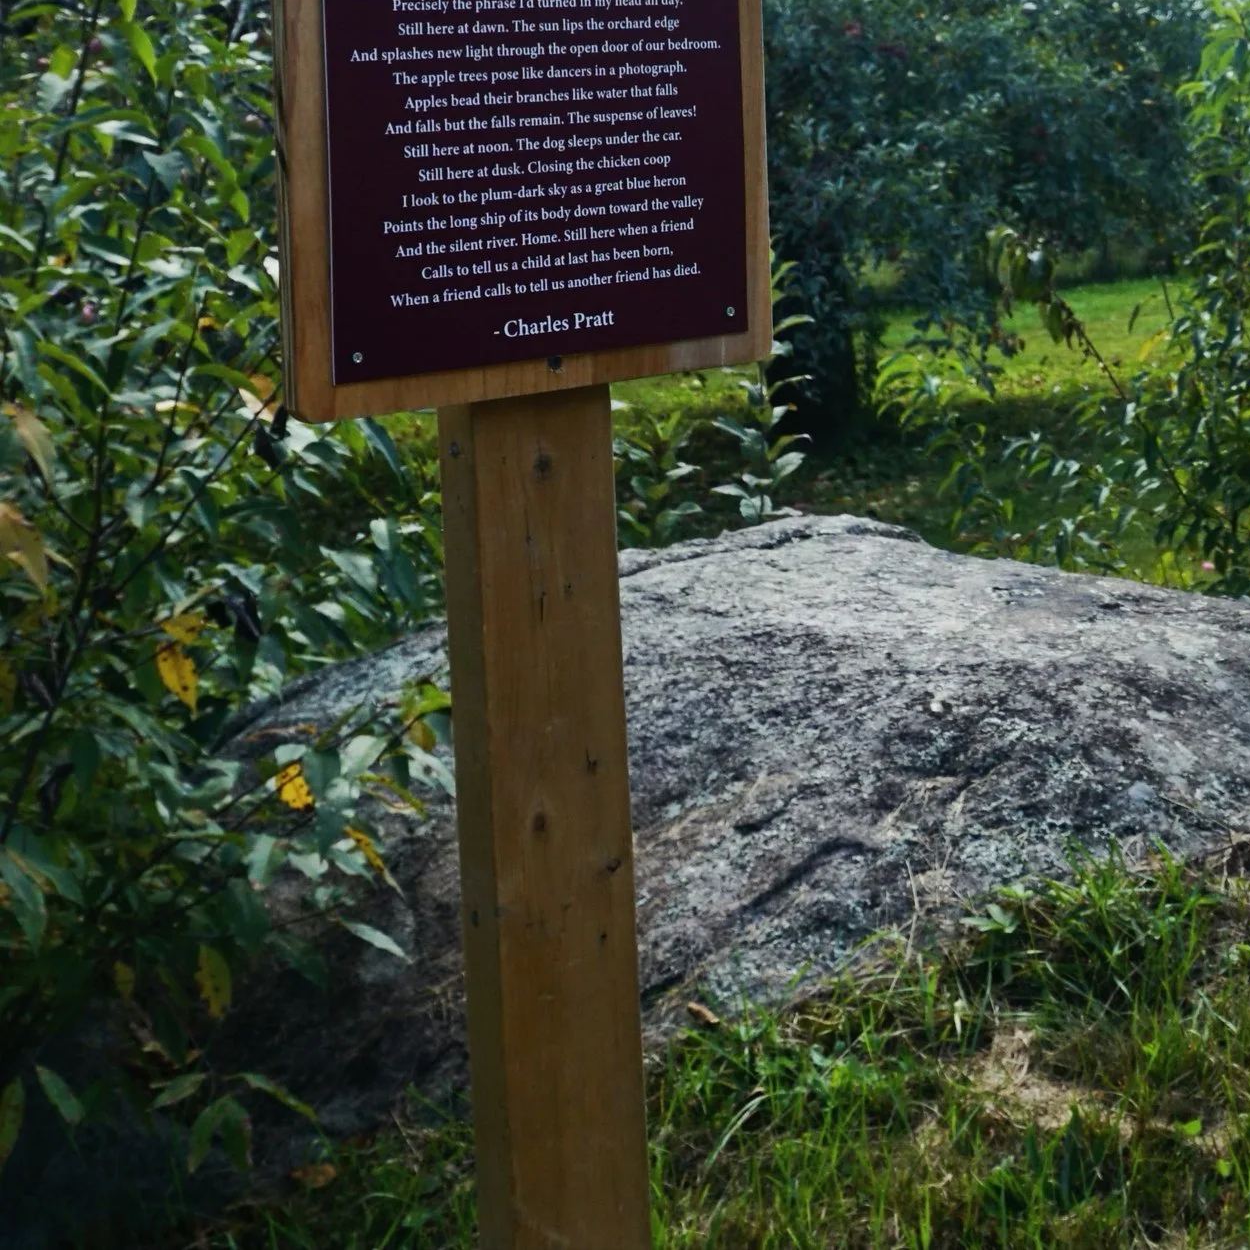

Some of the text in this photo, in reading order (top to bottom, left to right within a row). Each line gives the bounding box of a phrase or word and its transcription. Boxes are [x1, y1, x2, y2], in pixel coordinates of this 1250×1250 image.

[398, 15, 680, 36] Still here at dawn. The sun lips the orchard edge
[350, 37, 722, 65] And splashes new light through the open door of our bedroom.
[392, 60, 688, 88] The apple trees pose like dancers in a photograph.
[404, 83, 679, 113] Apples bead their branches like water that falls
[384, 104, 697, 135] And falls but the falls remain. The suspense of leaves!
[403, 129, 683, 159] Still here at noon. The dog sleeps under the car.
[418, 154, 672, 183] Still here at dusk. Closing the chicken coop
[402, 175, 687, 208] I look to the plum-dark sky as a great blue heron
[383, 195, 705, 235] Points the long ship of its body down toward the valley
[395, 217, 695, 258] And the silent river. Home. Still here when a friend
[421, 244, 674, 280] Calls to tell us a child at last has been born,
[390, 262, 701, 308] When a friend calls to tell us another friend has died.
[503, 315, 570, 338] Charles
[573, 310, 615, 330] Pratt
